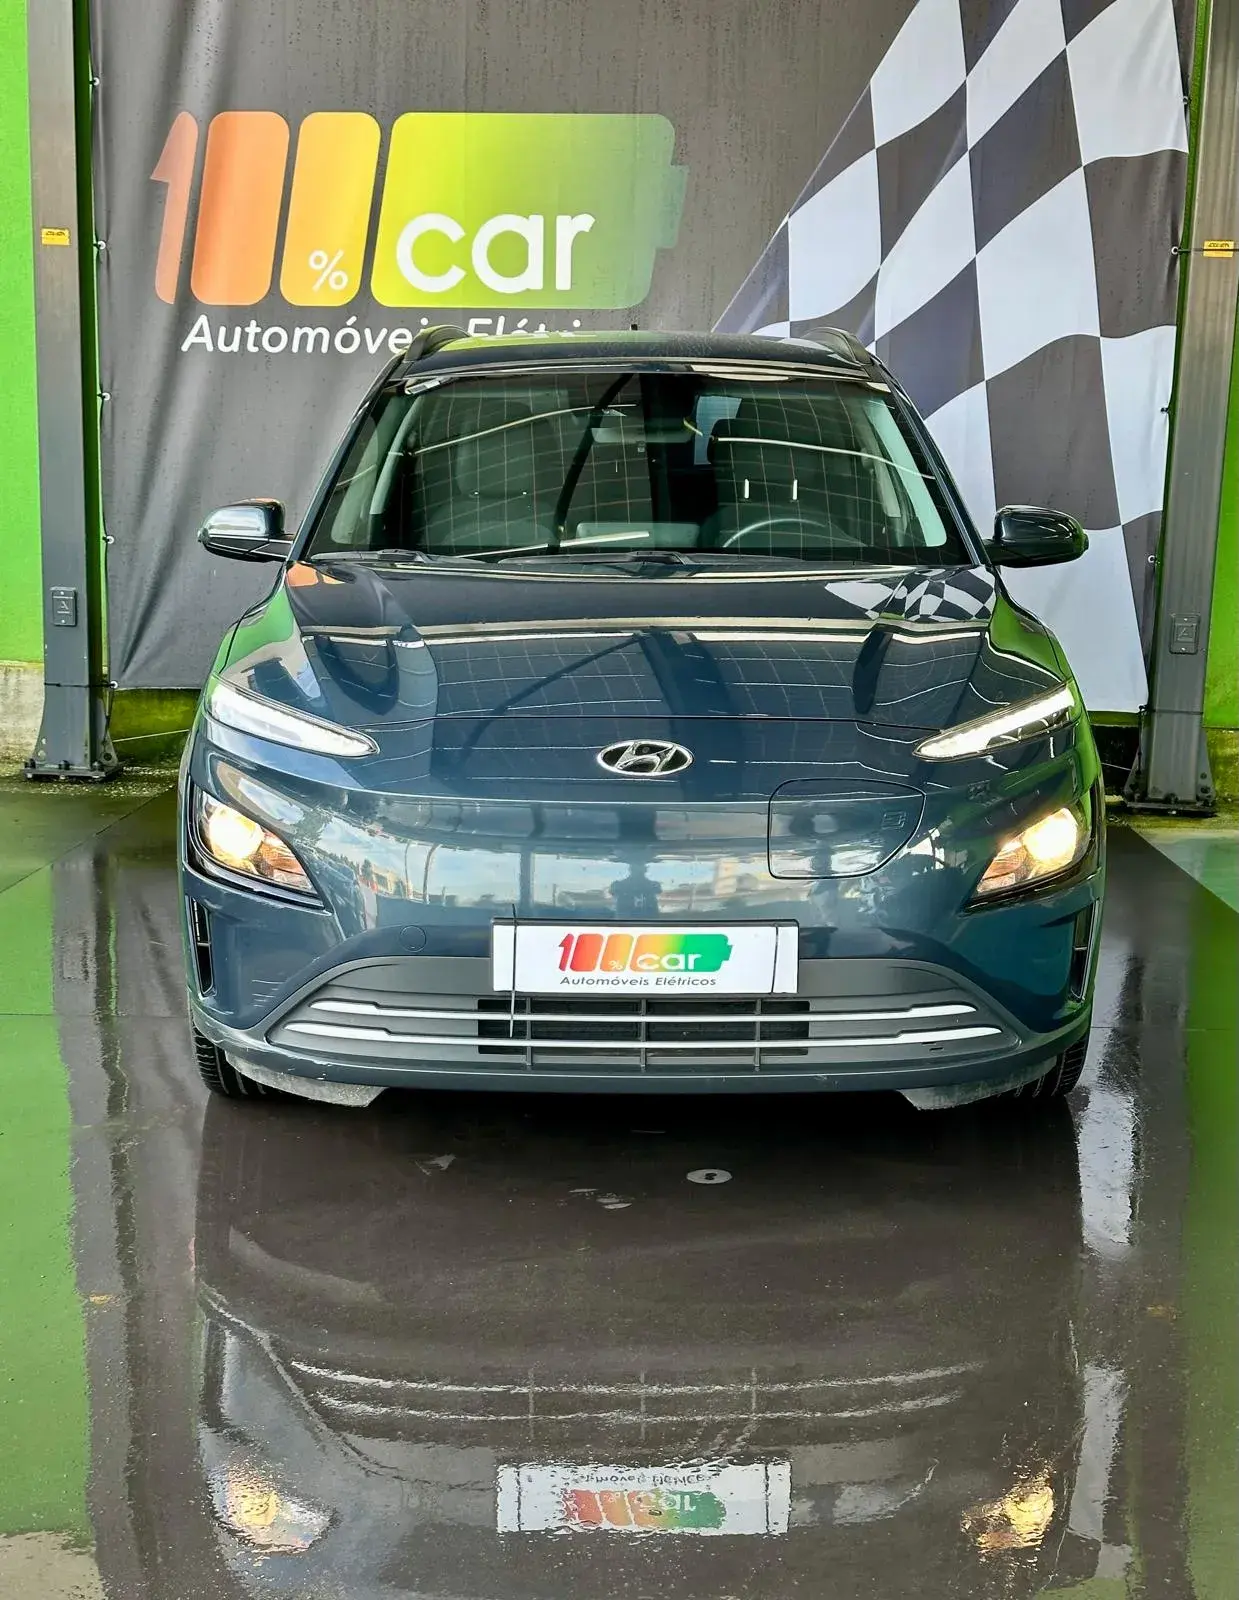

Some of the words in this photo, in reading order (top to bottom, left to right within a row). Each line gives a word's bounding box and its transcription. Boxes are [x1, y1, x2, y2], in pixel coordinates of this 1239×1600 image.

[396, 213, 595, 294] car
[636, 953, 702, 970] car
[560, 976, 649, 986] Automóveis
[655, 976, 716, 986] Elétricos
